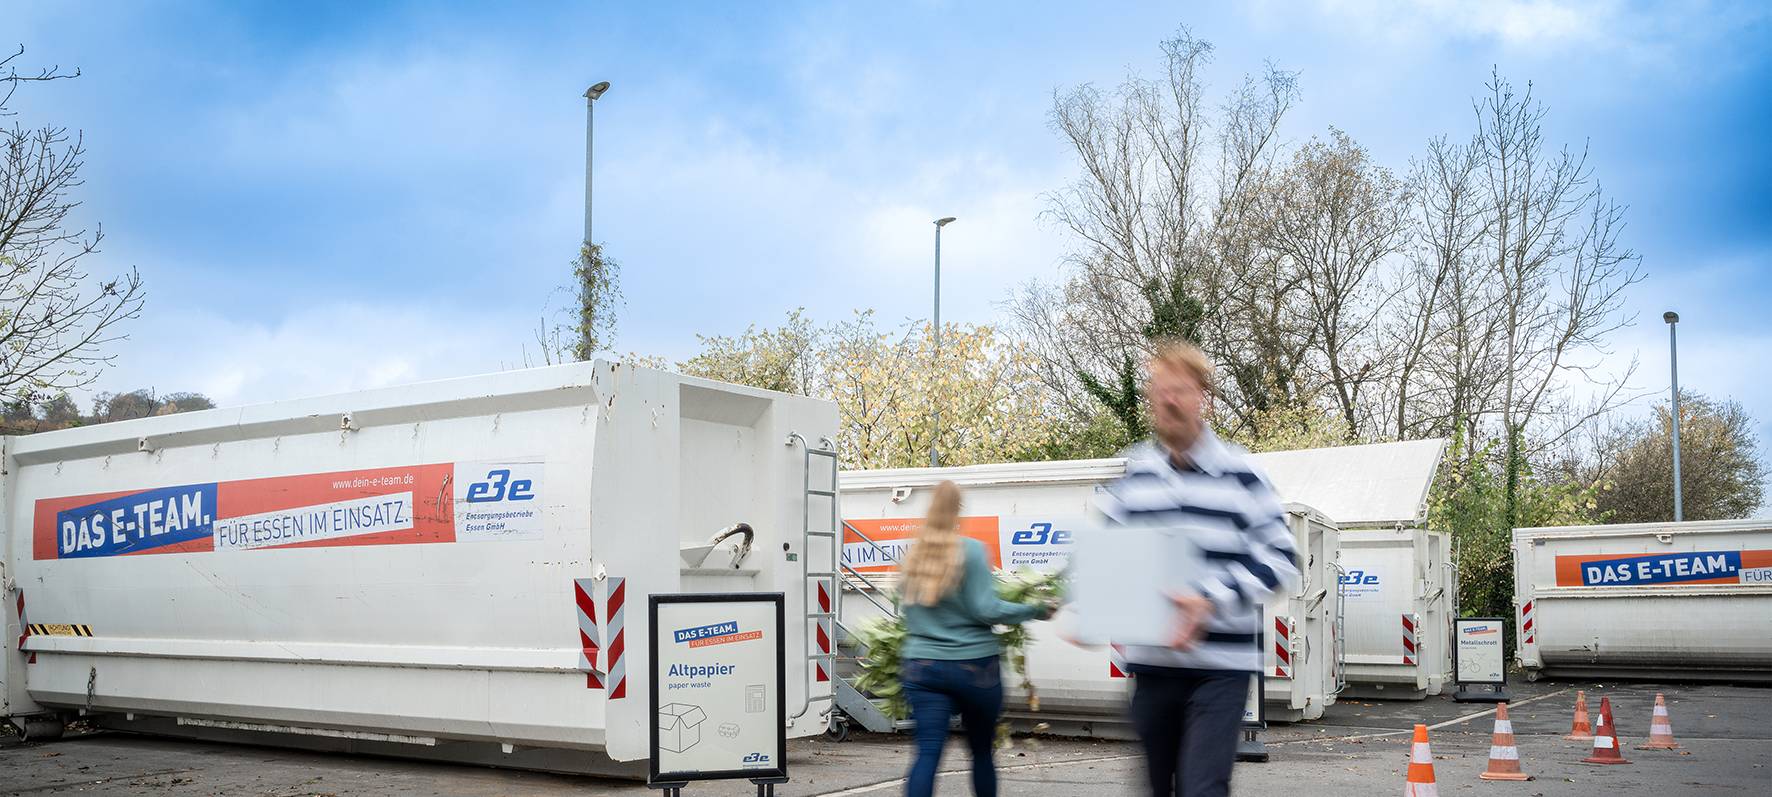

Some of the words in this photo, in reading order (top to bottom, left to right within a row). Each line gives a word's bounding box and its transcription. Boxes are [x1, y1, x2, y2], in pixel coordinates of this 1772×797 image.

[332, 473, 414, 489] www.dein-e-team.de
[466, 469, 535, 503] e3e
[62, 514, 106, 554] DAS
[111, 490, 211, 544] E-TEAM.
[465, 510, 533, 520] Entsorgungsbetriebe
[219, 519, 249, 547] FÜR
[253, 515, 304, 542] ESSEN
[309, 511, 327, 535] IM
[333, 500, 410, 532] EINSATZ.
[465, 523, 485, 532] Essen
[486, 522, 505, 531] GmbH
[1011, 523, 1074, 545] e3e
[857, 547, 875, 563] IM
[1586, 563, 1632, 584] DAS
[1637, 554, 1736, 580] E-TEAM.
[1744, 568, 1772, 582] FÜR
[678, 630, 697, 641] DAS
[699, 623, 736, 637] E-TEAM.
[704, 636, 726, 646] ESSEN
[668, 662, 736, 679] Altpapier
[668, 682, 689, 690] paper
[690, 681, 712, 689] waste
[742, 752, 770, 763] e3e
